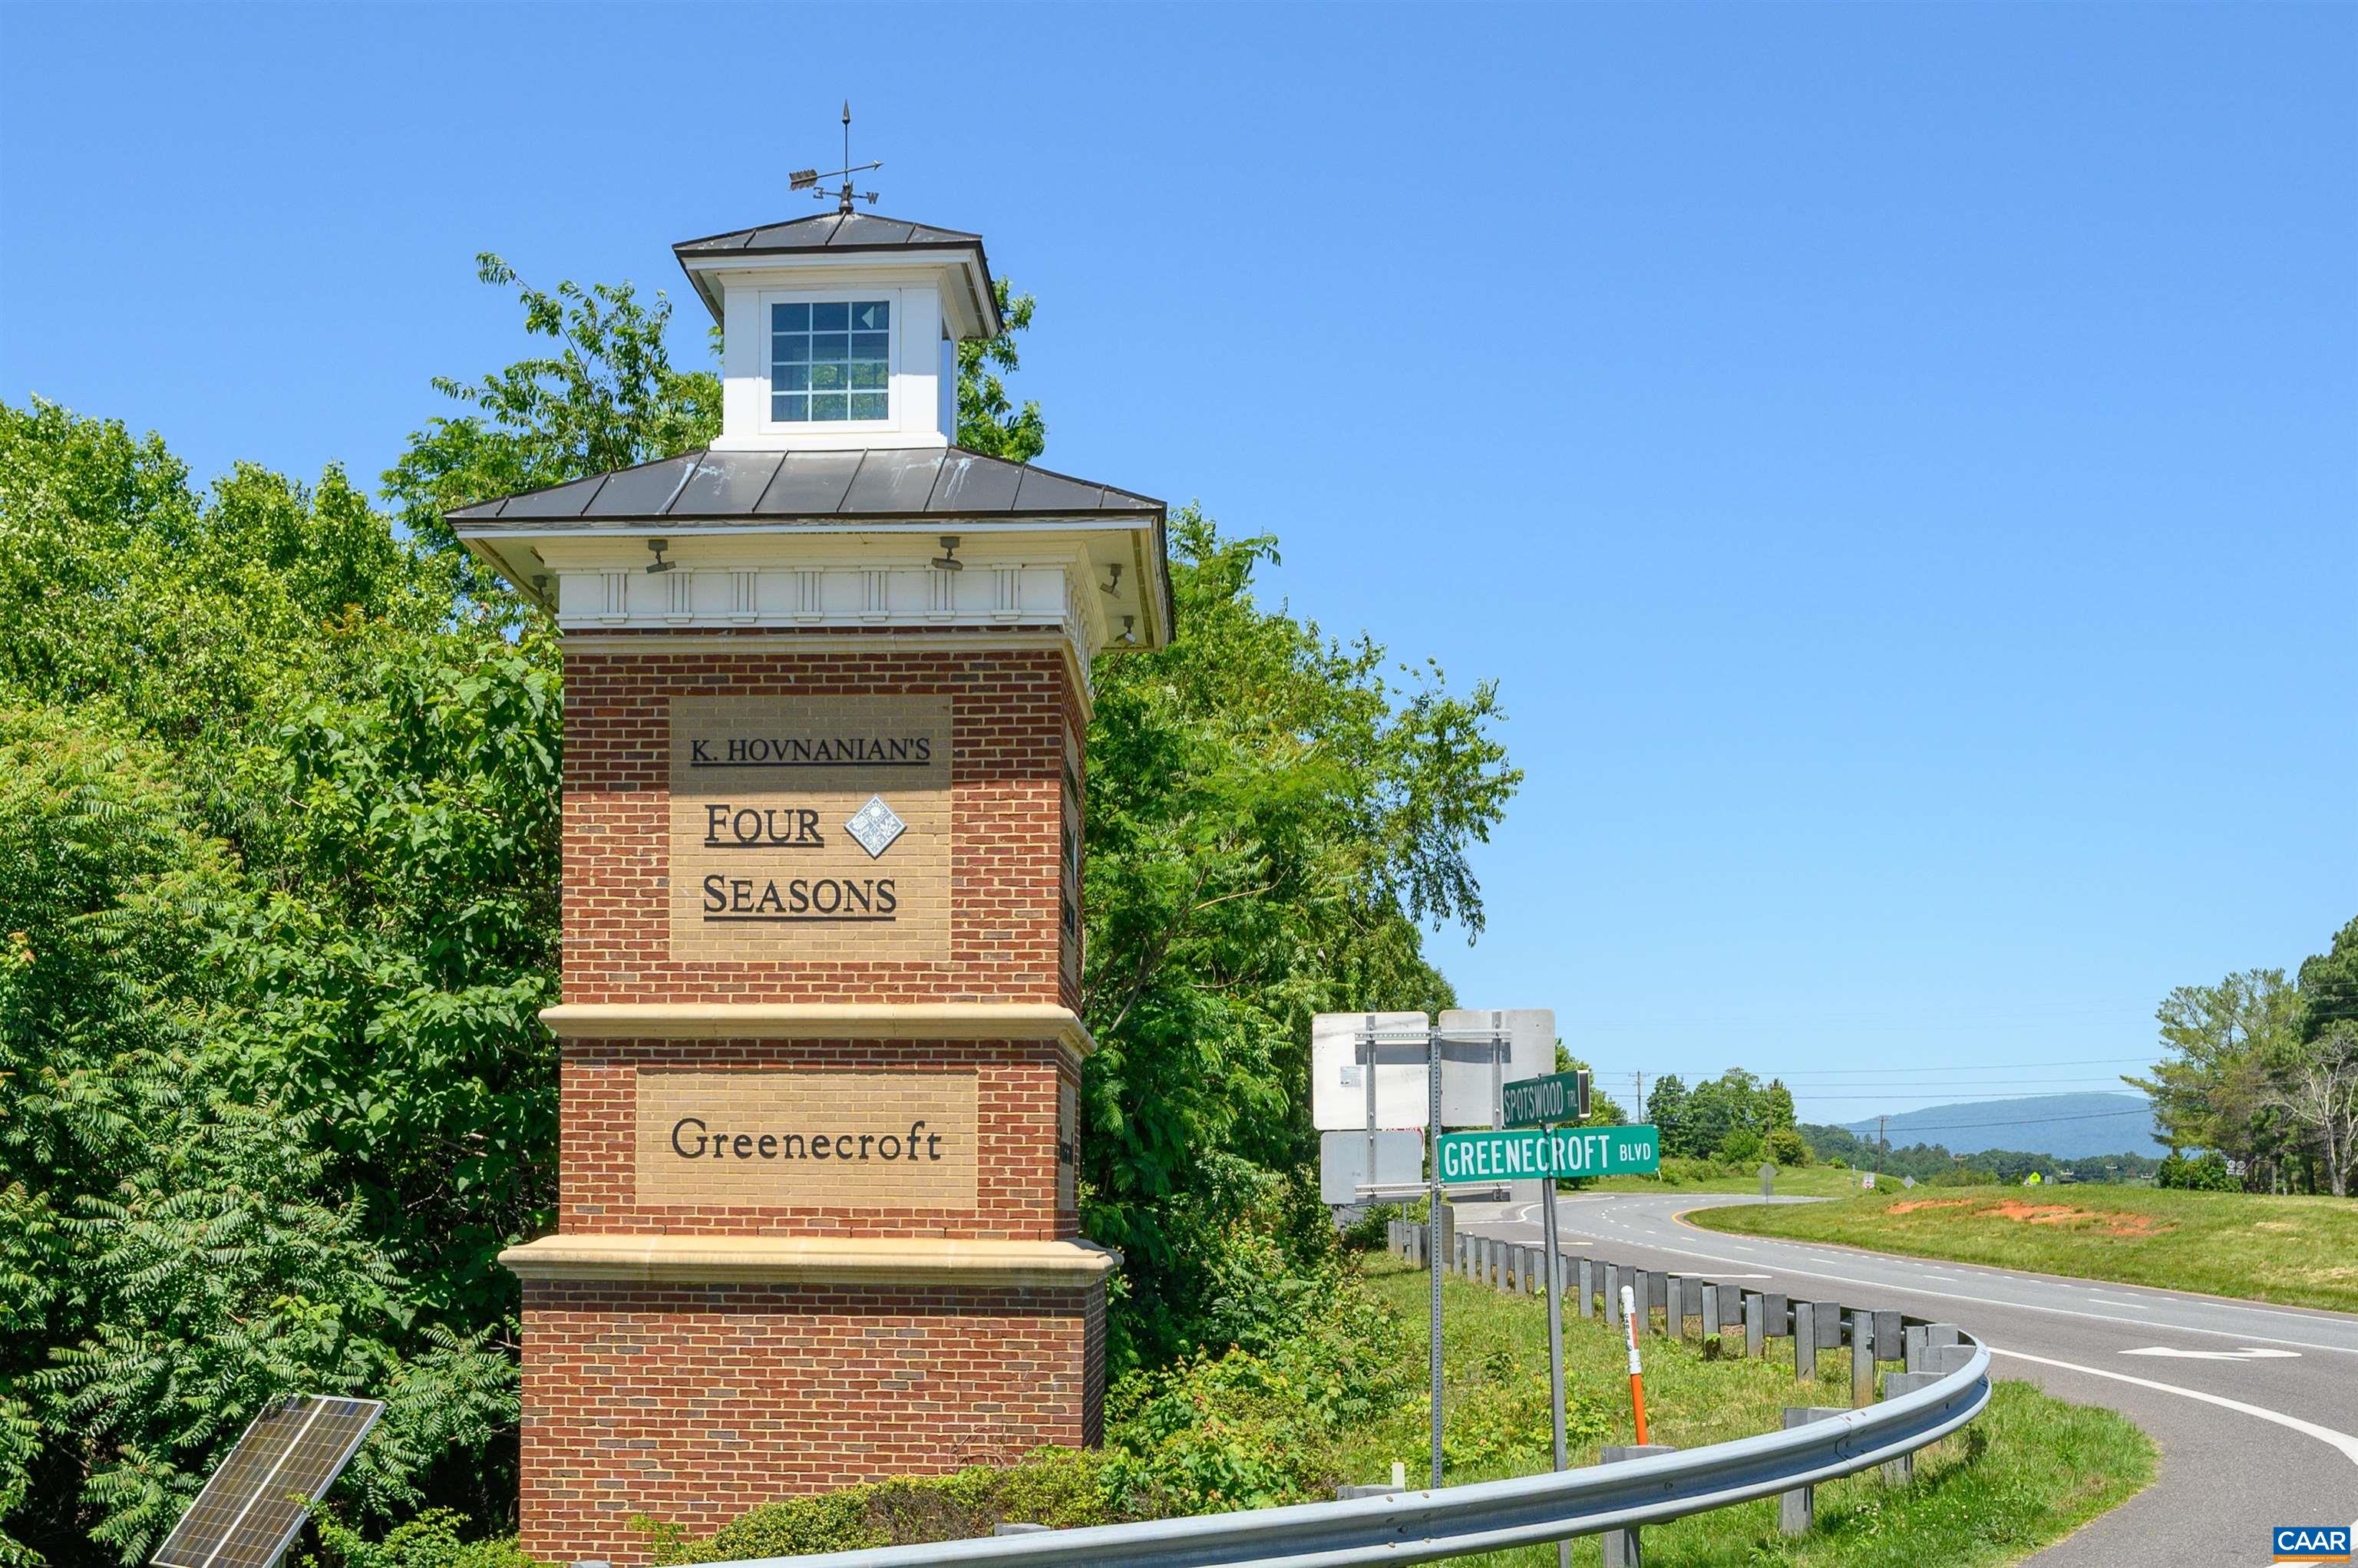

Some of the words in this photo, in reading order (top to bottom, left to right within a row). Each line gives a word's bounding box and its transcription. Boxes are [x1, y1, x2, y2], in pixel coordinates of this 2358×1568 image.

[691, 739, 717, 761] K.
[728, 738, 930, 761] HOVNANIAN'S
[704, 804, 824, 843] FOUR
[703, 873, 897, 914] SEASONS
[1504, 1081, 1564, 1123] SPOTSWOOD
[1567, 1090, 1577, 1108] TRL
[672, 1117, 942, 1161] Greenecroft
[1444, 1134, 1610, 1177] GREENECROFT
[1619, 1142, 1651, 1162] BLVD
